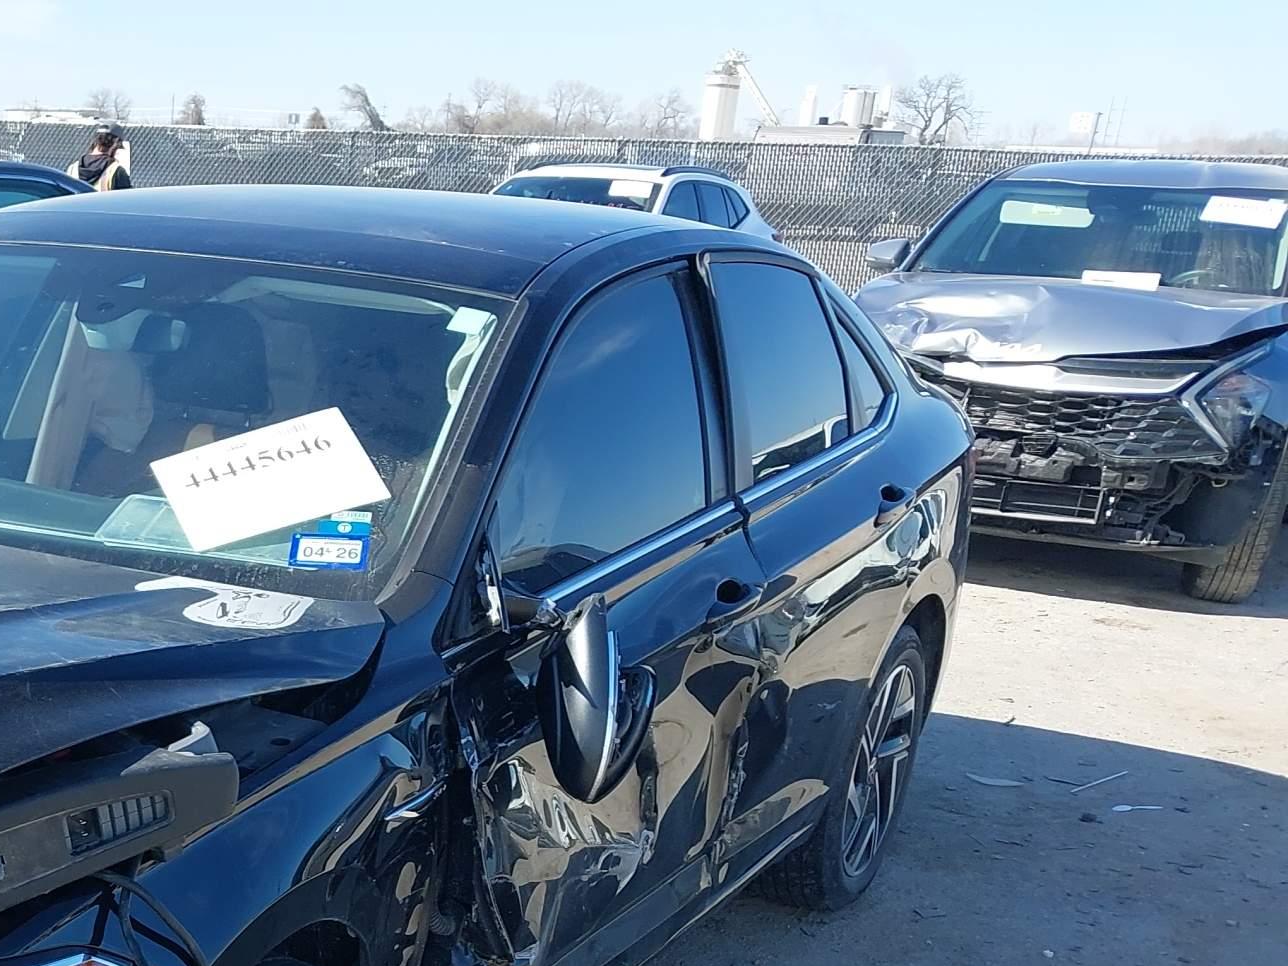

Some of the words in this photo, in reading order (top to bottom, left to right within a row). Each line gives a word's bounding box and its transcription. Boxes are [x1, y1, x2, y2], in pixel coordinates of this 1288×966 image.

[184, 434, 331, 489] 44445646
[303, 546, 325, 558] 04
[336, 547, 359, 560] 26
